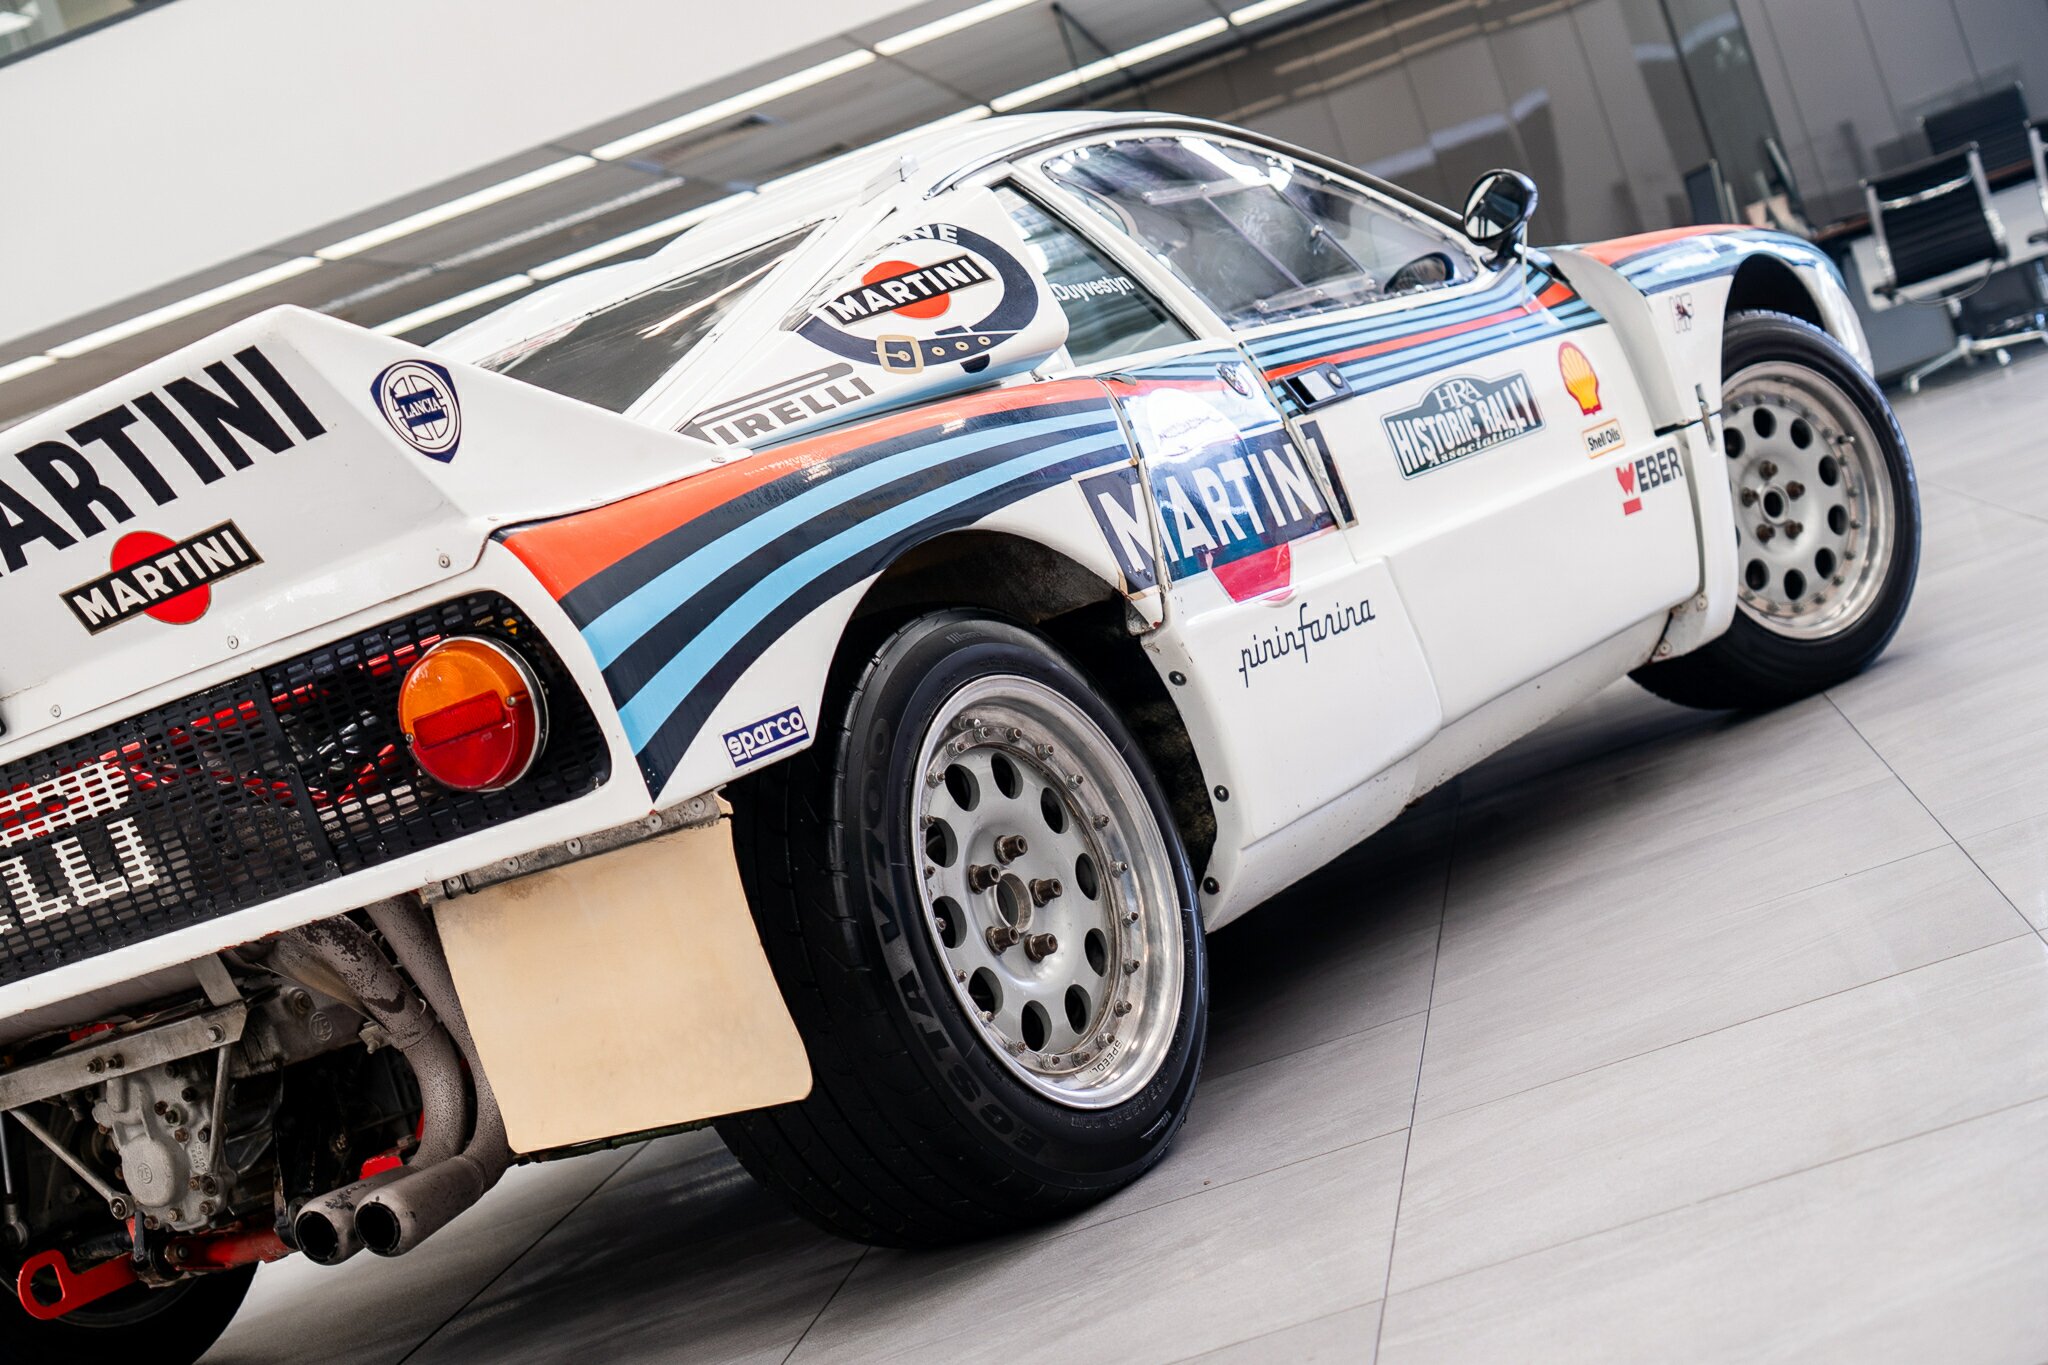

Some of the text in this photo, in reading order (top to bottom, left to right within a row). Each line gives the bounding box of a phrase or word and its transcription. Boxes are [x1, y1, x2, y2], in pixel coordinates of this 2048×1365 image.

[828, 258, 984, 321] MARTINI
[401, 396, 442, 420] LANCIA
[1432, 379, 1483, 411] HRA
[1388, 376, 1537, 474] HISTORIC RALLY
[1428, 428, 1526, 467] Association
[1587, 429, 1621, 451] Shell Oils
[0, 345, 327, 577] ARTINI
[1616, 447, 1683, 496] WEBER
[1098, 437, 1346, 571] MARTINI
[72, 529, 249, 626] MARTINI
[1239, 599, 1376, 688] pininfarina
[727, 711, 804, 760] sparco
[1088, 1040, 1122, 1073] SPEEDL
